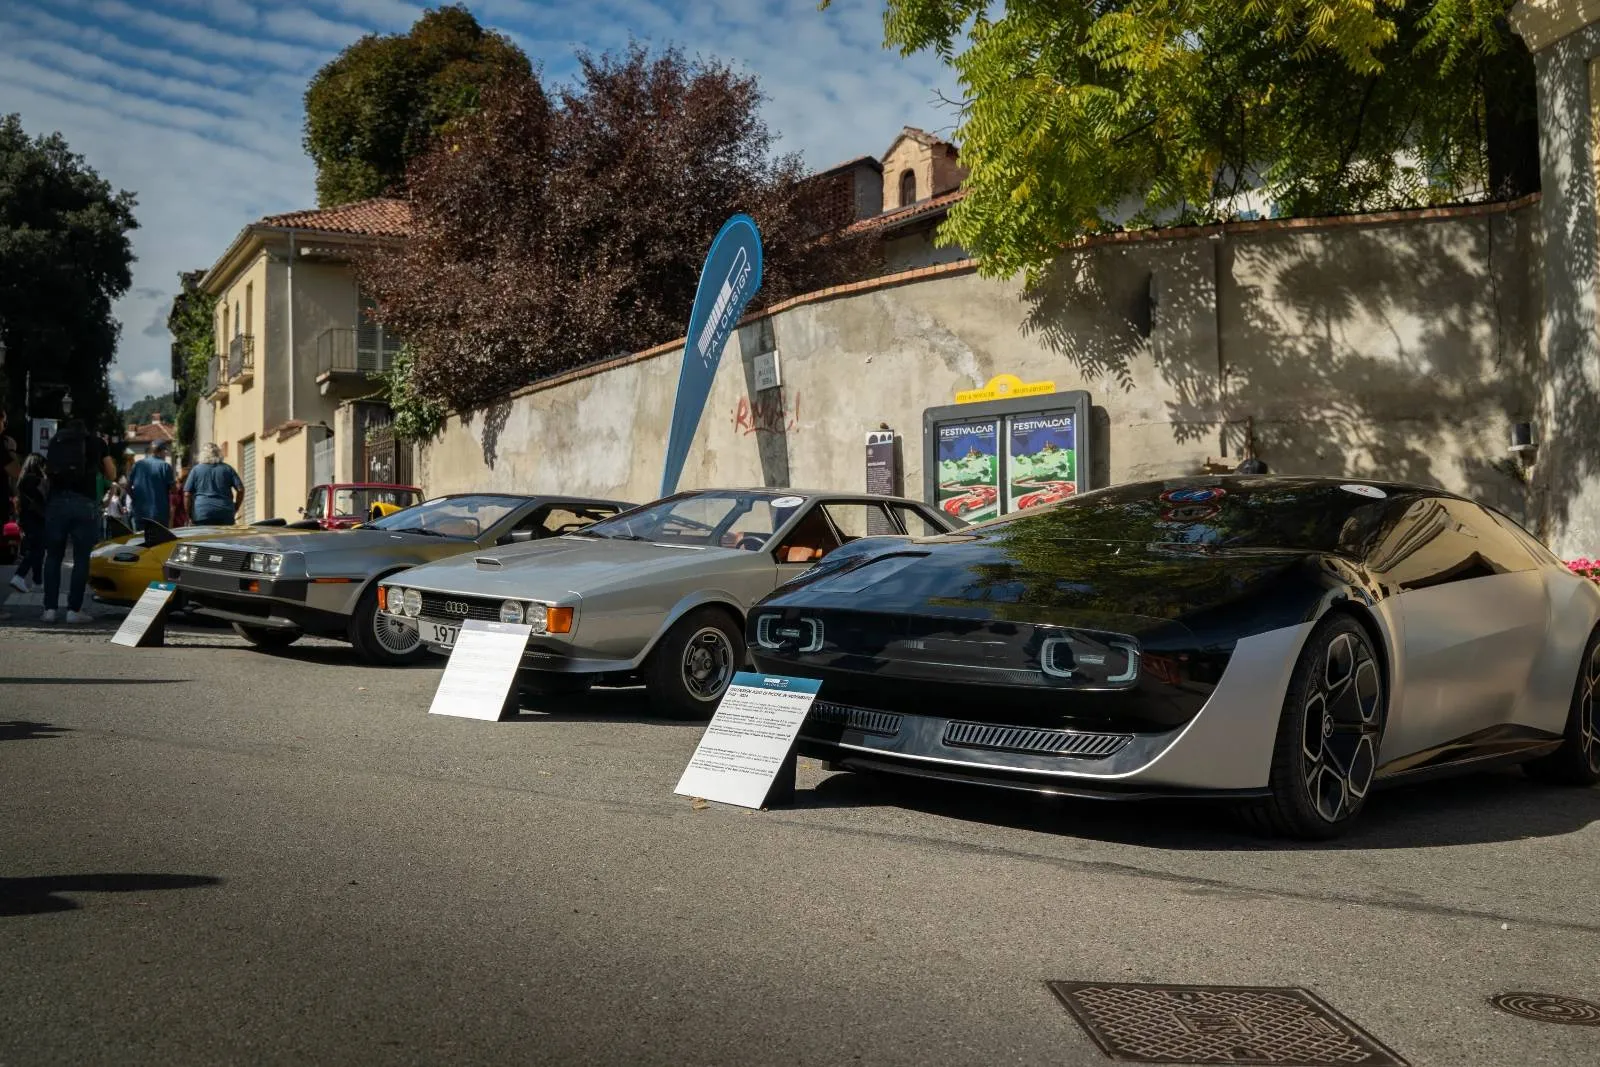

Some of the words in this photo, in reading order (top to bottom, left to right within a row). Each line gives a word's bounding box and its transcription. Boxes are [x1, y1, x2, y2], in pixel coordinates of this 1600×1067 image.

[703, 261, 752, 369] ITALDESIGN
[940, 424, 994, 436] FESTIVALCAR
[1013, 417, 1071, 430] FESTIVALCAR
[433, 625, 461, 643] 197
